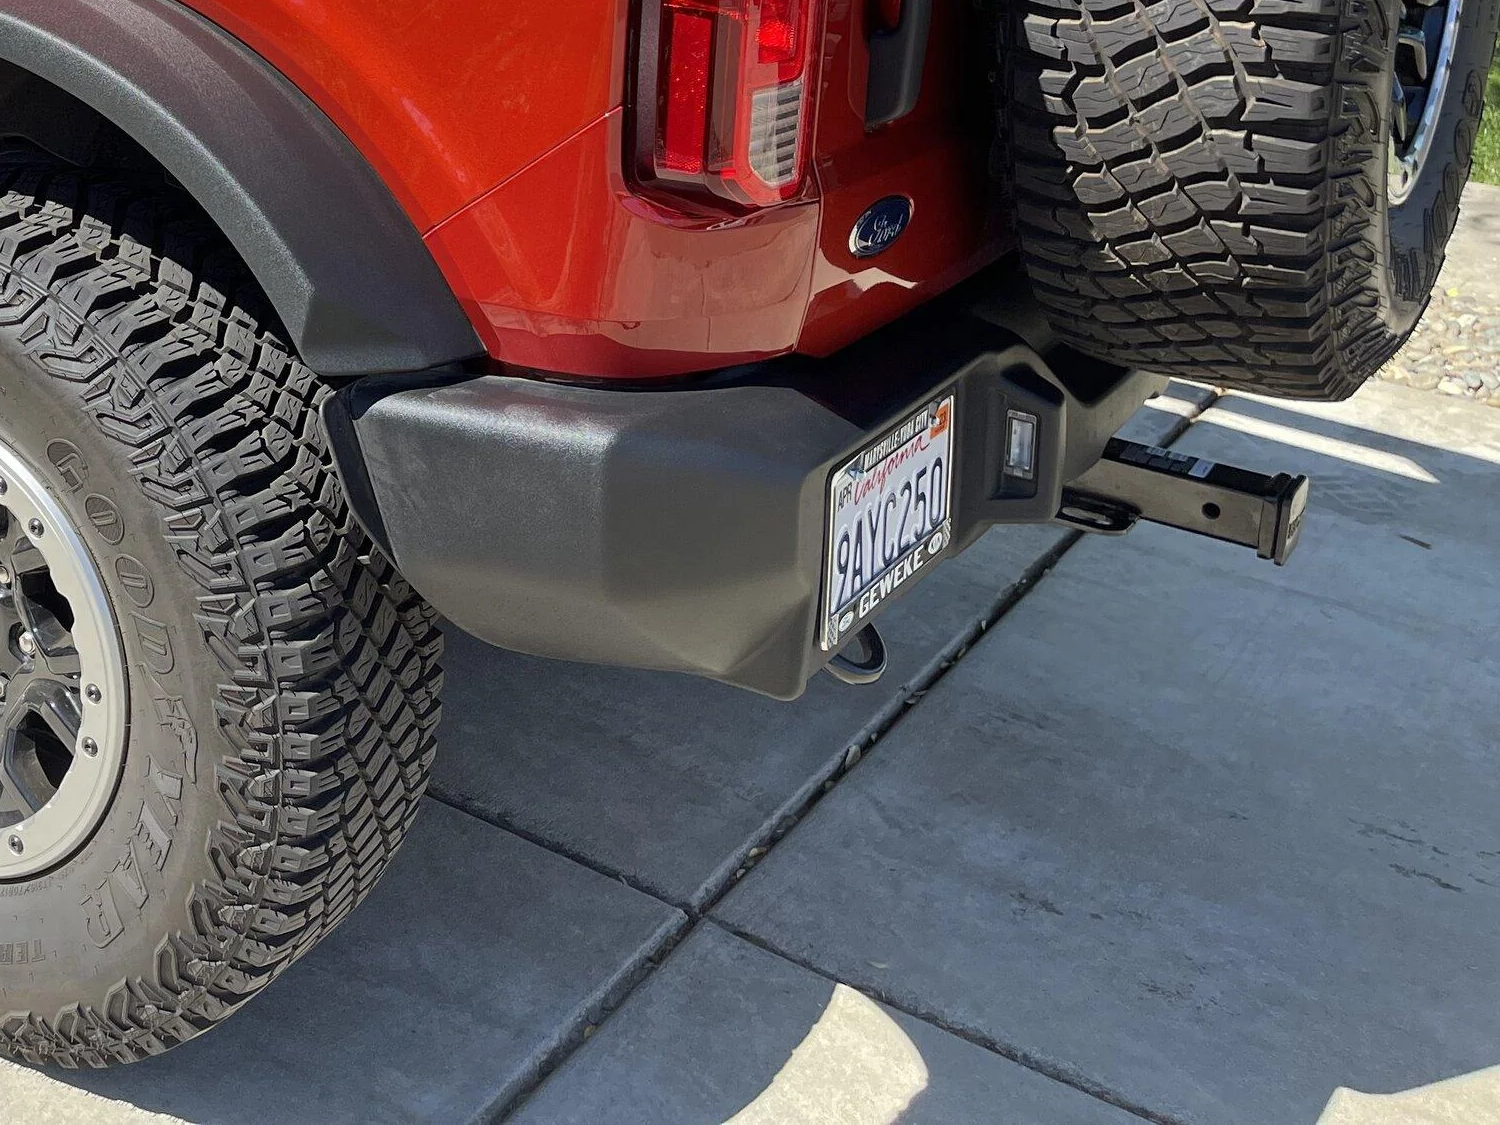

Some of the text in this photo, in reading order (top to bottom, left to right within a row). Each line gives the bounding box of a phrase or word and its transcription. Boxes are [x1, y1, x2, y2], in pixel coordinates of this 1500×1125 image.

[837, 482, 853, 512] APR
[854, 434, 930, 506] California
[835, 456, 944, 612] 9AYC250
[858, 544, 925, 619] GEWEKE
